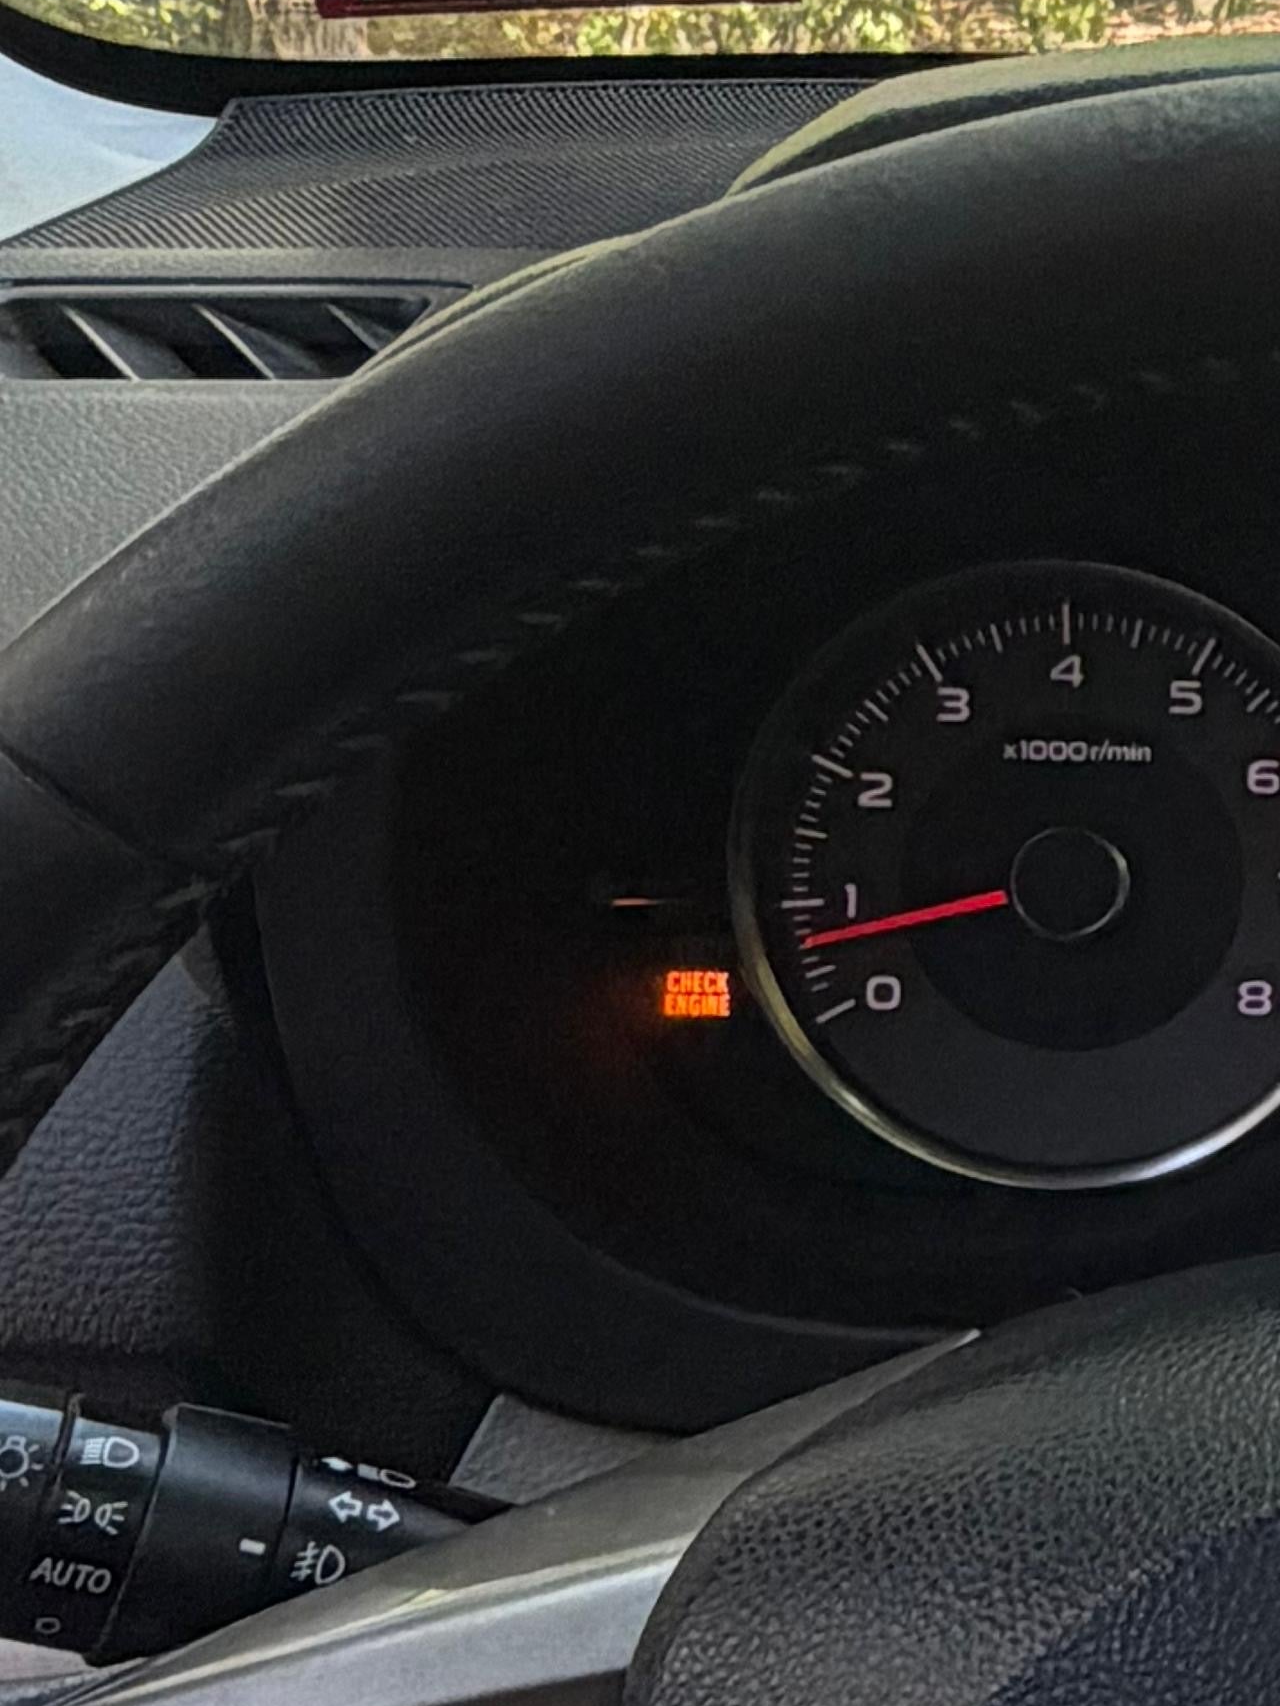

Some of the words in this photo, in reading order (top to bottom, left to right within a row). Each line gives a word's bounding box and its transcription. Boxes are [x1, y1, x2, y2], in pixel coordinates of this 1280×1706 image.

[1050, 654, 1084, 687] 4
[936, 687, 971, 722] 3
[1169, 680, 1201, 715] 5
[857, 773, 893, 809] 2
[1246, 760, 1280, 794] 6
[843, 884, 858, 918] 1
[666, 970, 730, 994] CHECK
[865, 975, 901, 1010] 0
[1237, 980, 1273, 1015] 8
[663, 993, 731, 1017] ENGINE
[29, 1556, 113, 1594] AUTO
